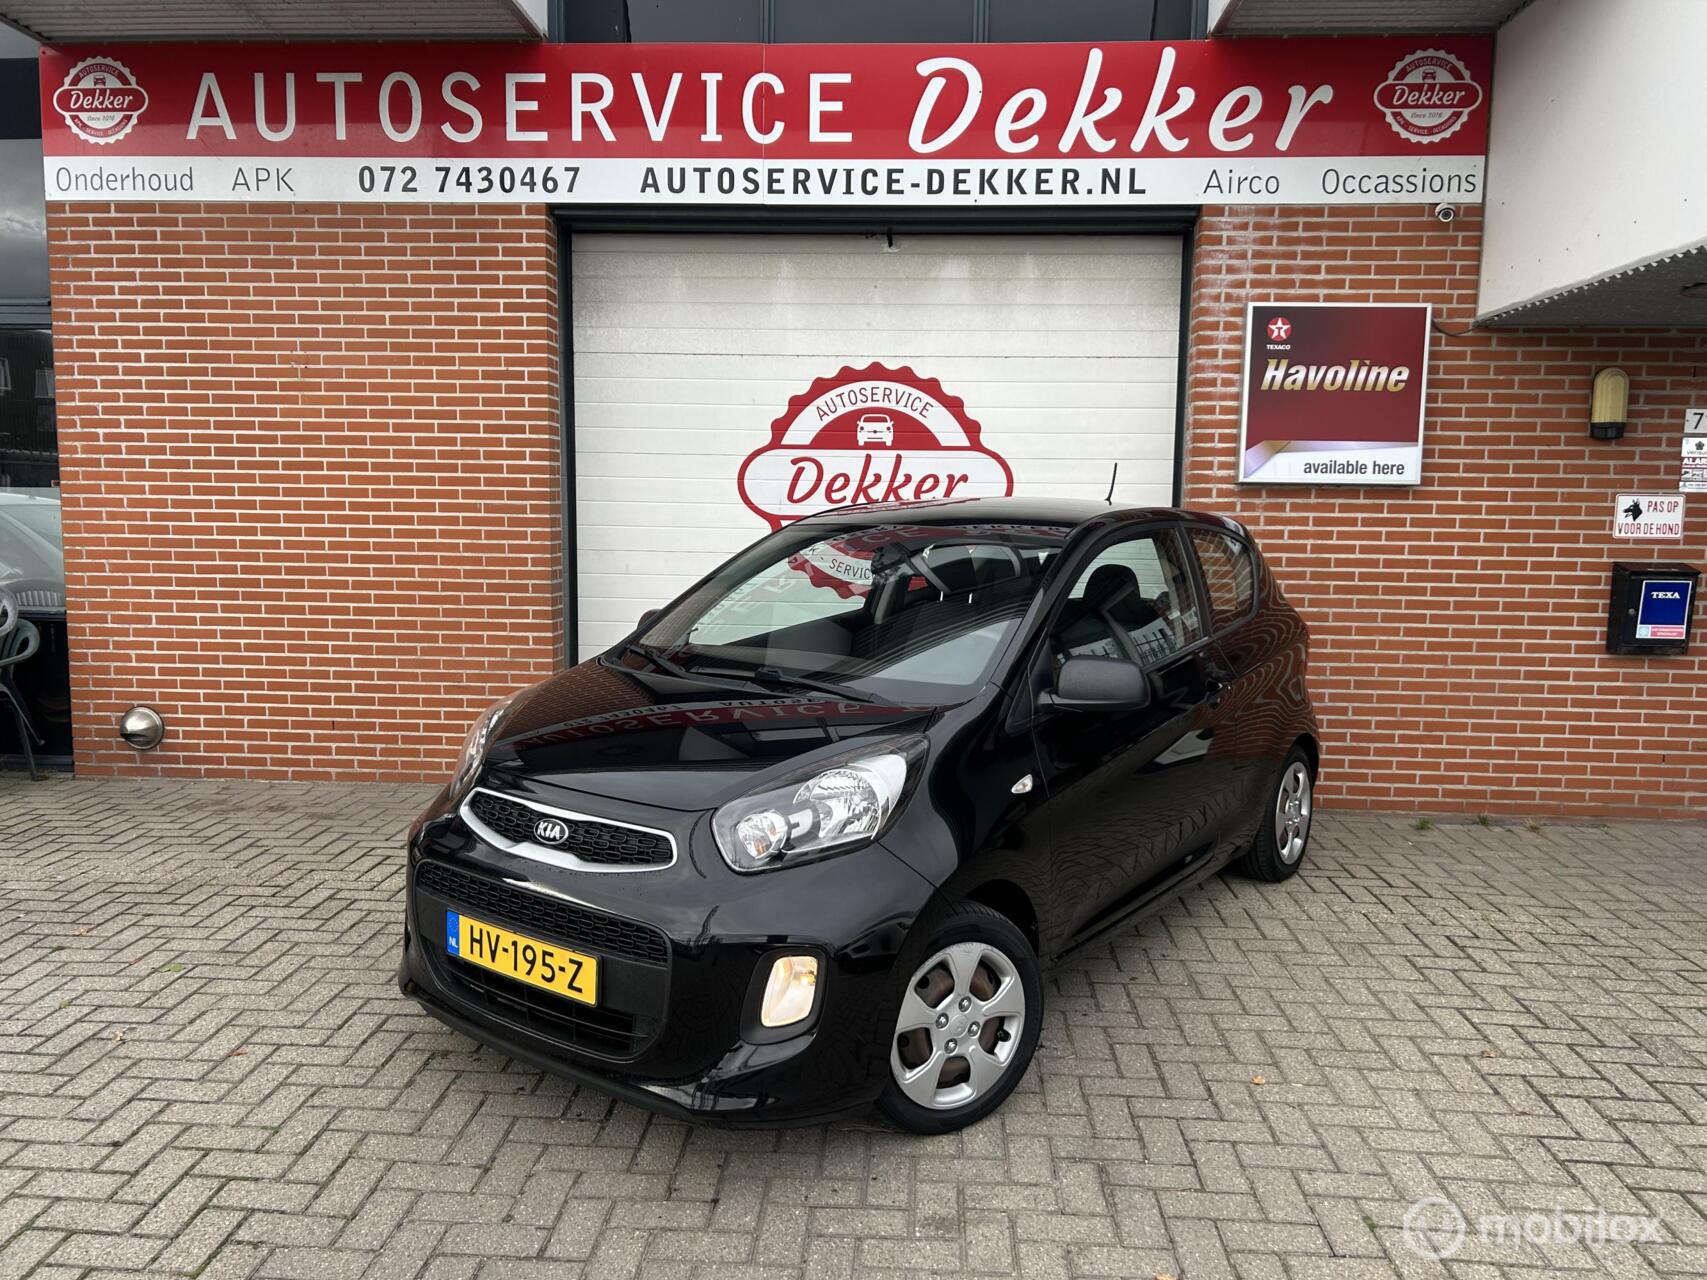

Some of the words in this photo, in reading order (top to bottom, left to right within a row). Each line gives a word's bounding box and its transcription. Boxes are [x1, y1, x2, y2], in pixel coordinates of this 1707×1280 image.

[1405, 57, 1453, 73] AUTOSERVICE
[70, 88, 133, 109] Dekker
[186, 71, 852, 144] AUTOSERVICE
[908, 46, 1334, 154] Dekker
[1392, 82, 1466, 105] Dekker
[55, 166, 194, 192] Onderhoud
[231, 167, 295, 193] APK
[358, 165, 418, 193] 072
[435, 166, 581, 194] 7430467
[639, 166, 1147, 195] AUTOSERVICE-DEKKER.NL
[1203, 169, 1280, 195] Airco
[1321, 168, 1477, 195] Occassions
[1260, 358, 1410, 392] Havoline
[815, 386, 934, 422] AUTOSERVICE
[786, 453, 969, 505] Dekker
[1303, 460, 1368, 475] available
[1372, 460, 1405, 475] here
[1647, 500, 1665, 513] PAS
[1667, 500, 1680, 513] OP
[1617, 522, 1642, 535] VOOR
[1643, 523, 1655, 535] DE
[1655, 523, 1680, 536] HOND
[1650, 591, 1681, 599] TEXA
[537, 822, 562, 841] KIA
[449, 937, 459, 949] NL
[469, 924, 584, 994] HV-195-Z
